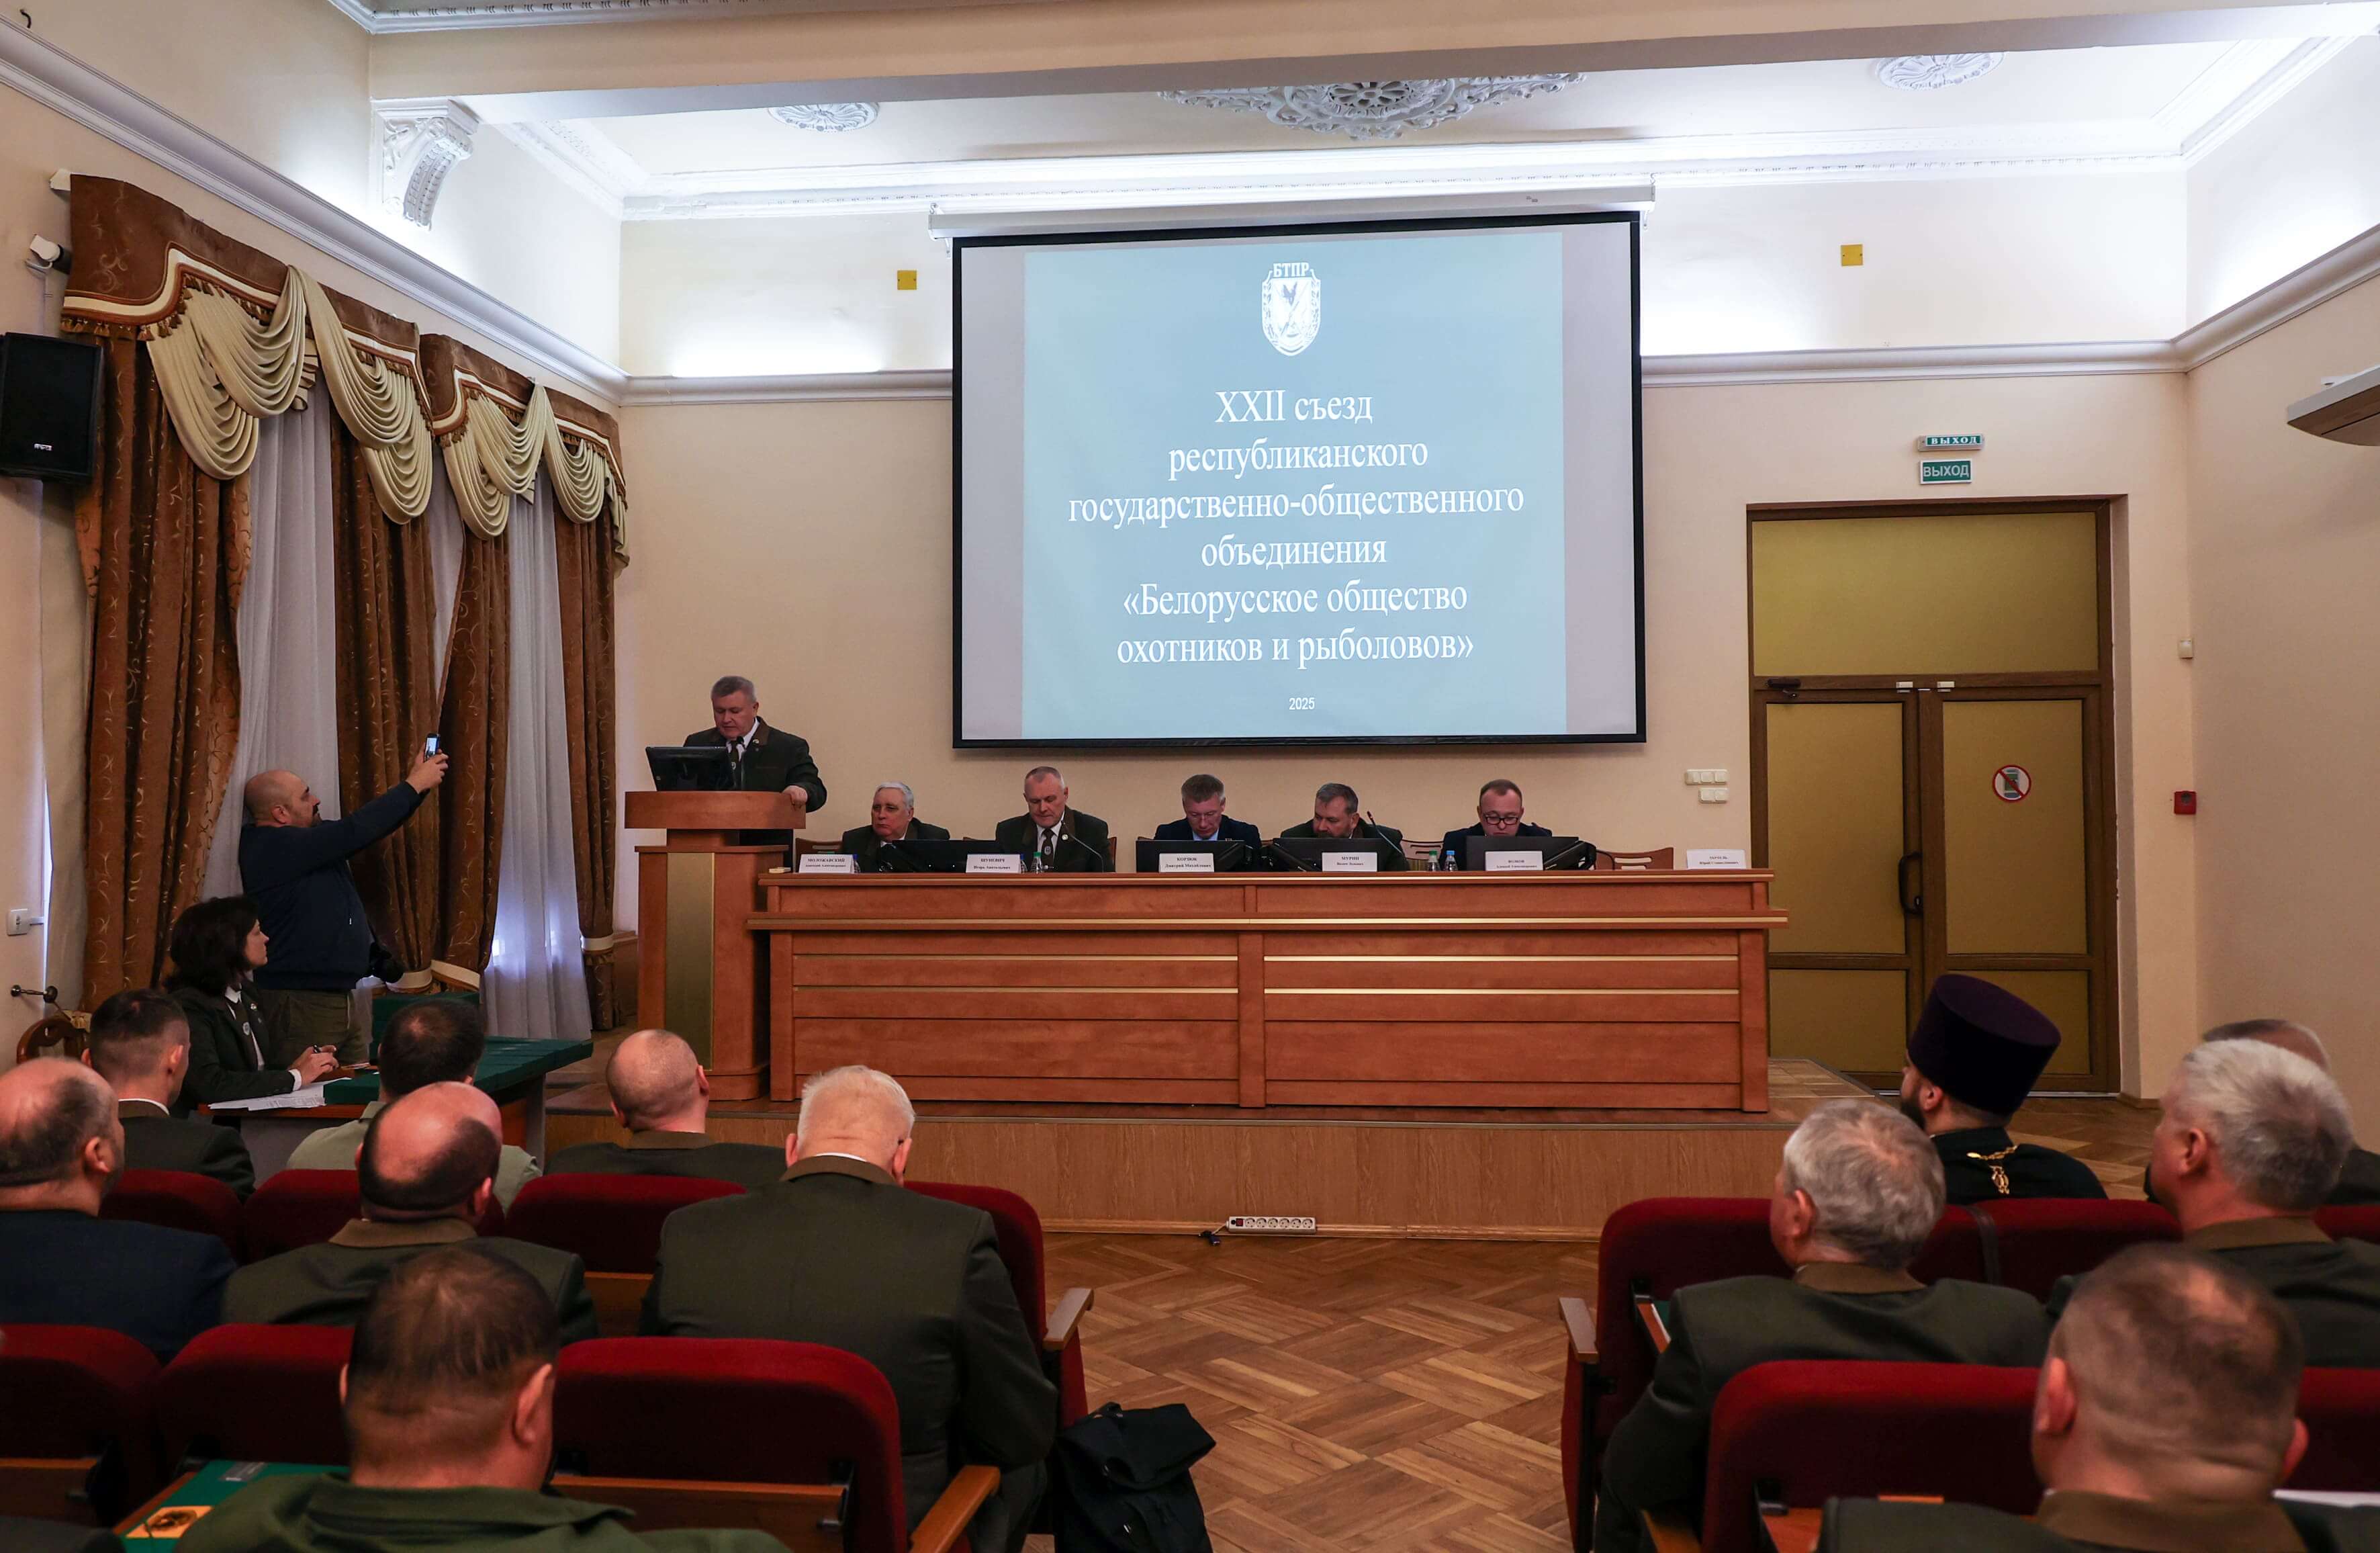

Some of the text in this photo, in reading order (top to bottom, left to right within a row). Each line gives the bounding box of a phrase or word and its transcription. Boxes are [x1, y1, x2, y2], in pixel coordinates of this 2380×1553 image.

[1273, 262, 1310, 277] БТПР
[1214, 390, 1373, 425] XXII съезд
[1931, 436, 1978, 445] ВЫХОД
[1167, 438, 1428, 481] республиканского
[1923, 464, 1970, 478] ВЫХОД
[1068, 483, 1524, 529] государственно-общественного
[1201, 534, 1387, 570] объединения
[1123, 579, 1468, 623] «Белорусское общество
[1116, 629, 1475, 670] охотников и рыболовов»
[1288, 697, 1316, 711] 2025
